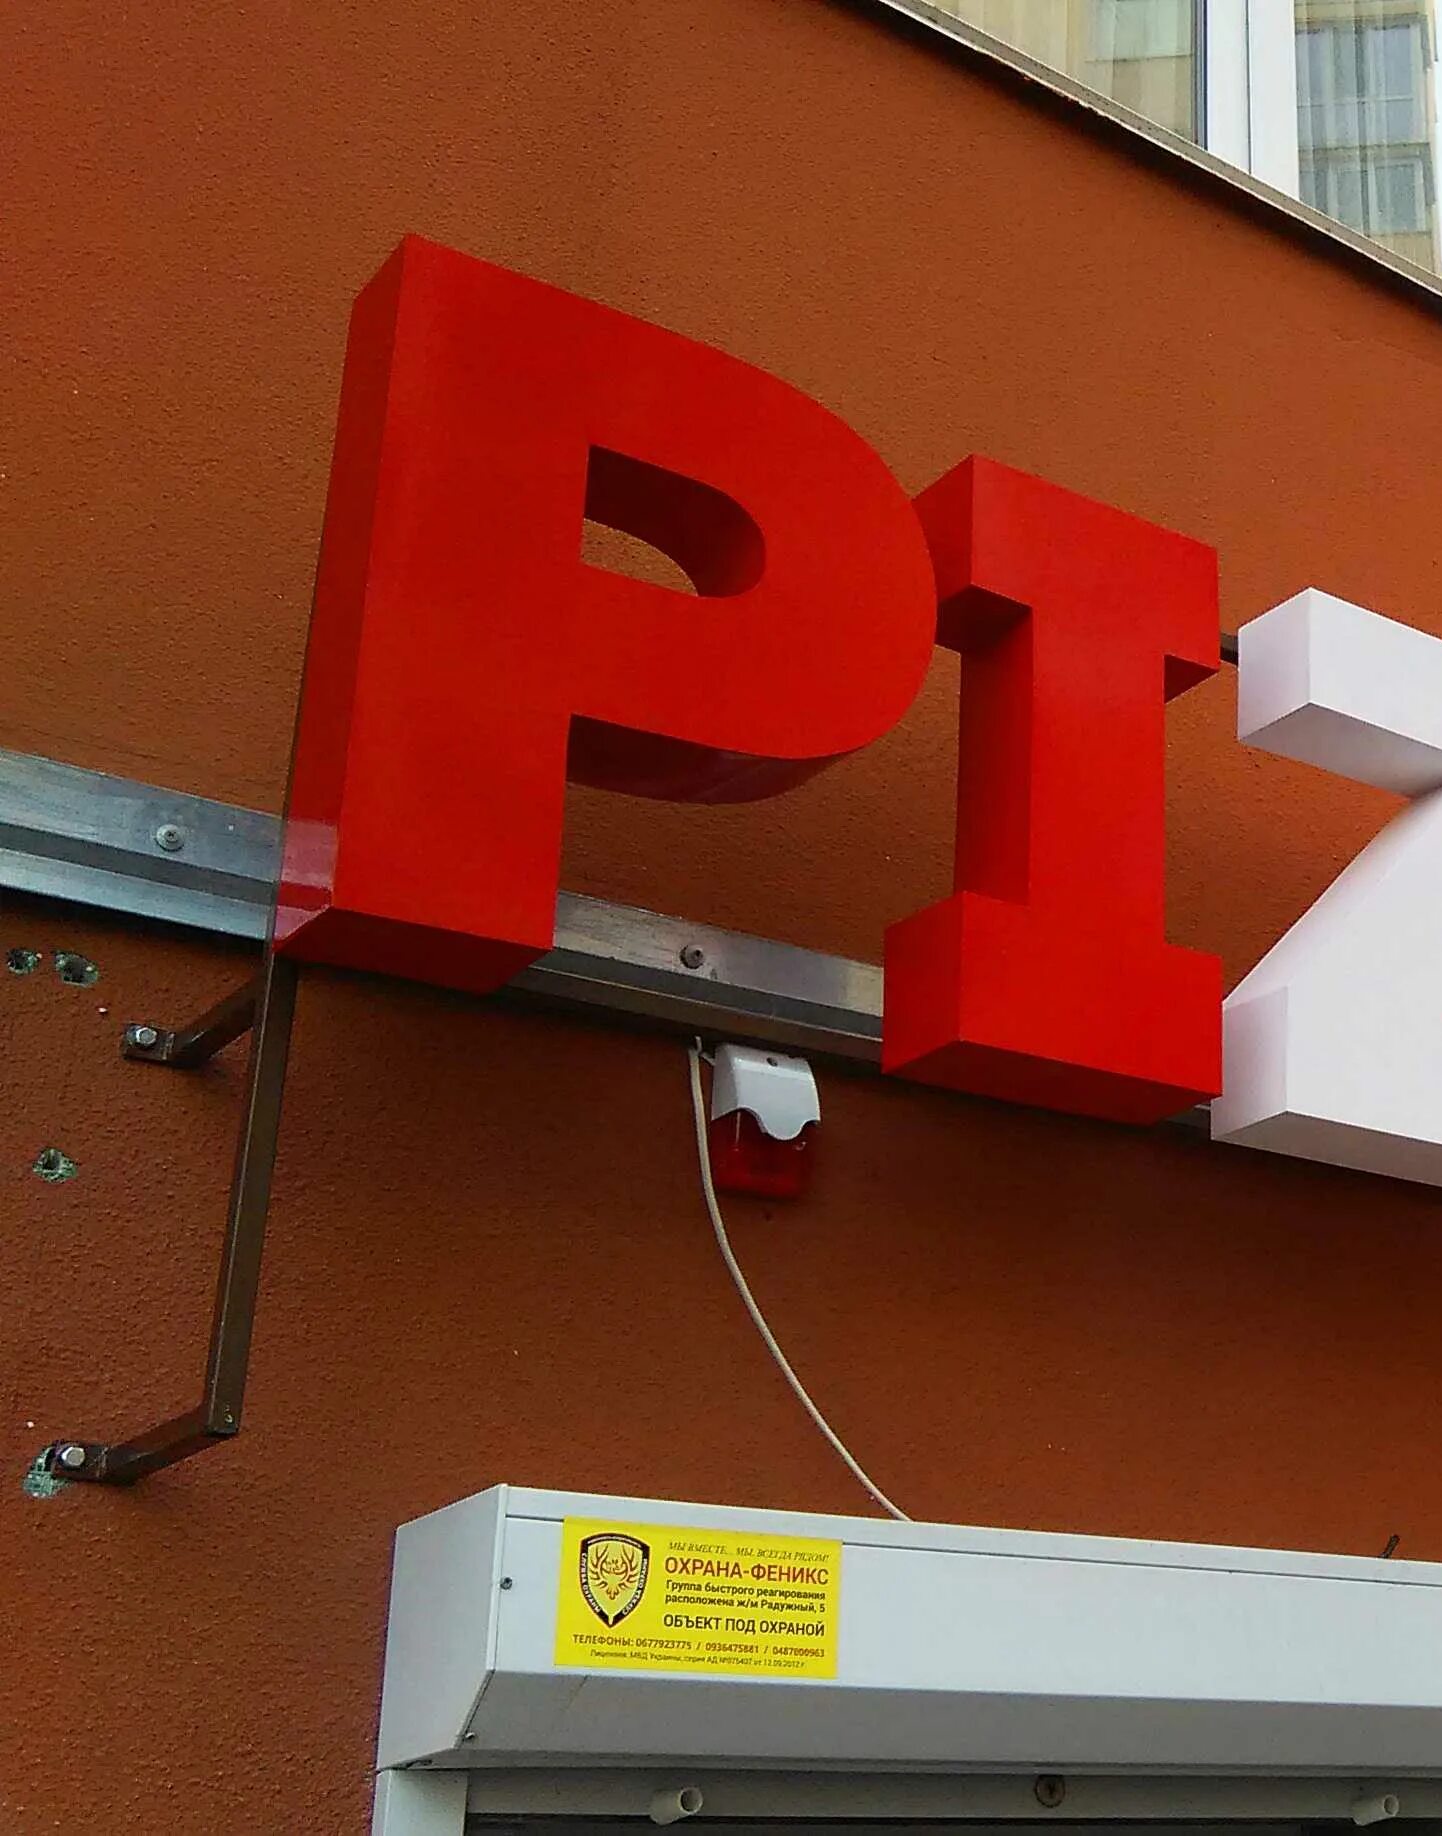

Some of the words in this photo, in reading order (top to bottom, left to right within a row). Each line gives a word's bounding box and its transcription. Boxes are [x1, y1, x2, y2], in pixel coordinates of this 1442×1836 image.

[665, 1556, 829, 1585] ОХРАНА-ФЕНИКС
[666, 1579, 702, 1593] Группа
[704, 1581, 754, 1596] быстрого
[756, 1587, 826, 1601] реагирования
[664, 1593, 734, 1608] расположена
[736, 1599, 759, 1609] ж/м
[760, 1600, 817, 1614] Радужный,
[819, 1603, 826, 1613] 5
[663, 1613, 722, 1630] ОБЪЕКТ
[725, 1618, 756, 1635] ПОД
[759, 1620, 825, 1637] ОХРАНОЙ
[572, 1634, 634, 1647] ТЕЛЕФОНЫ:
